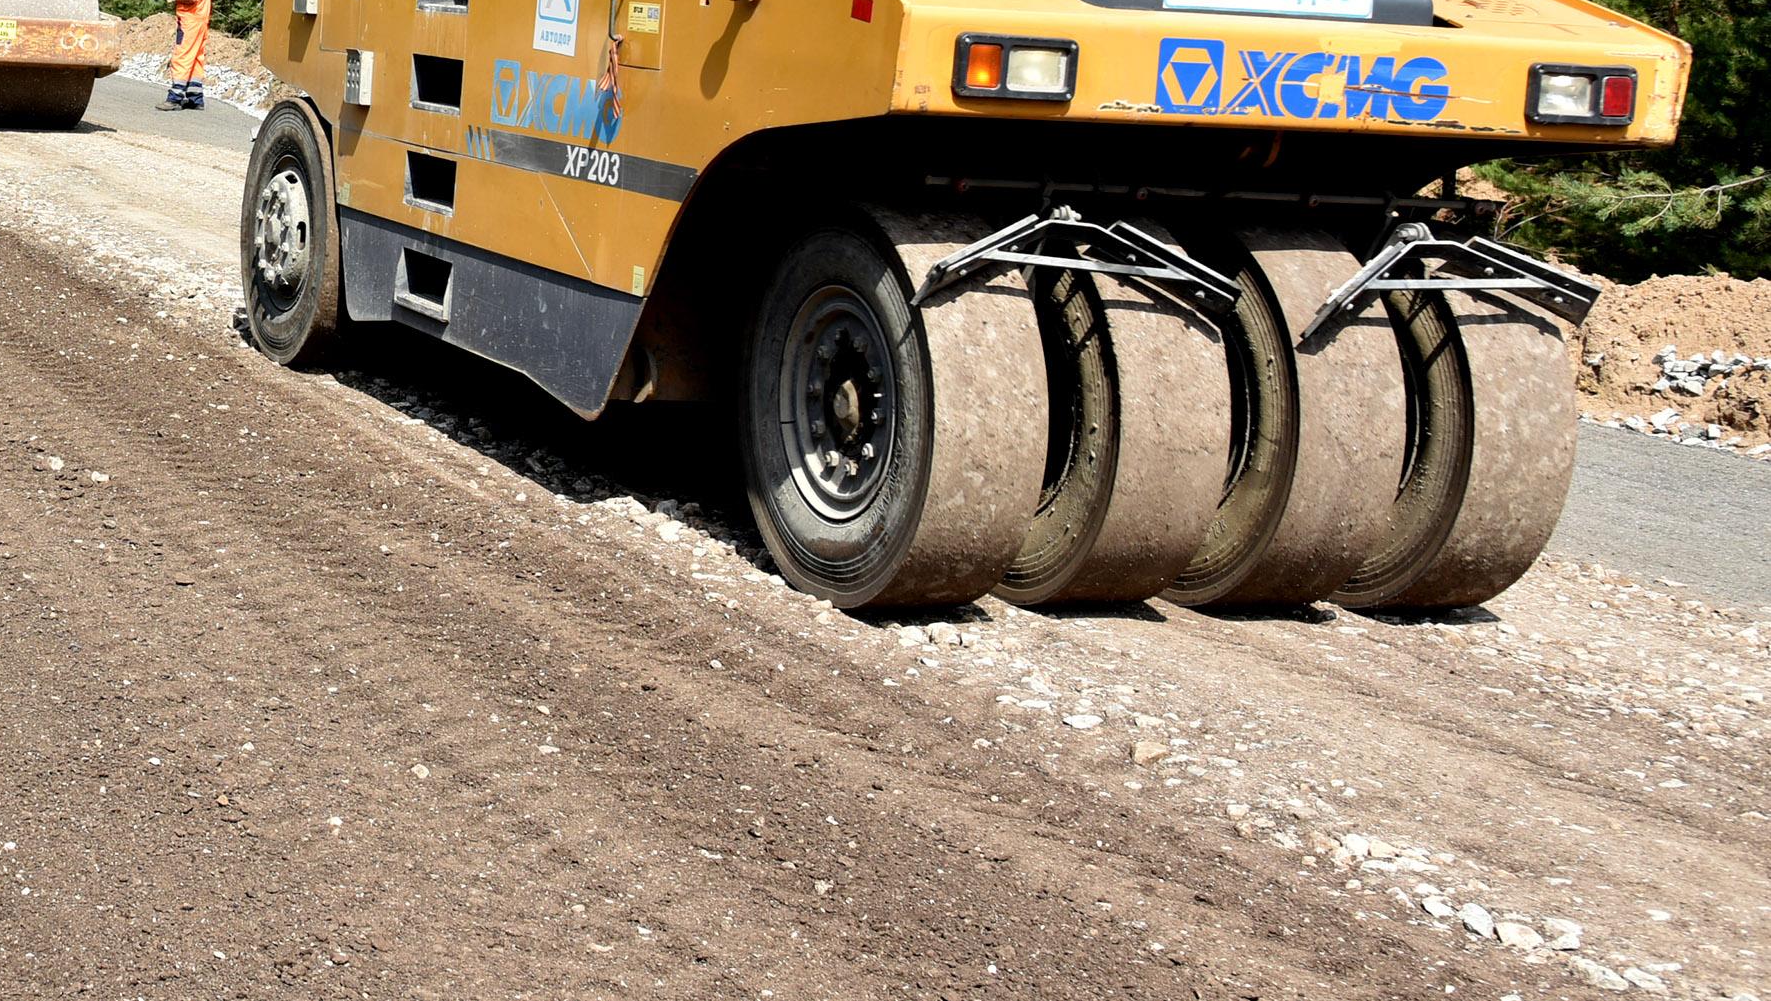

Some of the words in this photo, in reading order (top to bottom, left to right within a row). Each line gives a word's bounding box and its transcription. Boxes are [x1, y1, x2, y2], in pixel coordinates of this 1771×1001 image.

[540, 29, 572, 47] АВТОДОР
[1220, 50, 1450, 121] XCMG
[563, 145, 620, 185] XP203
